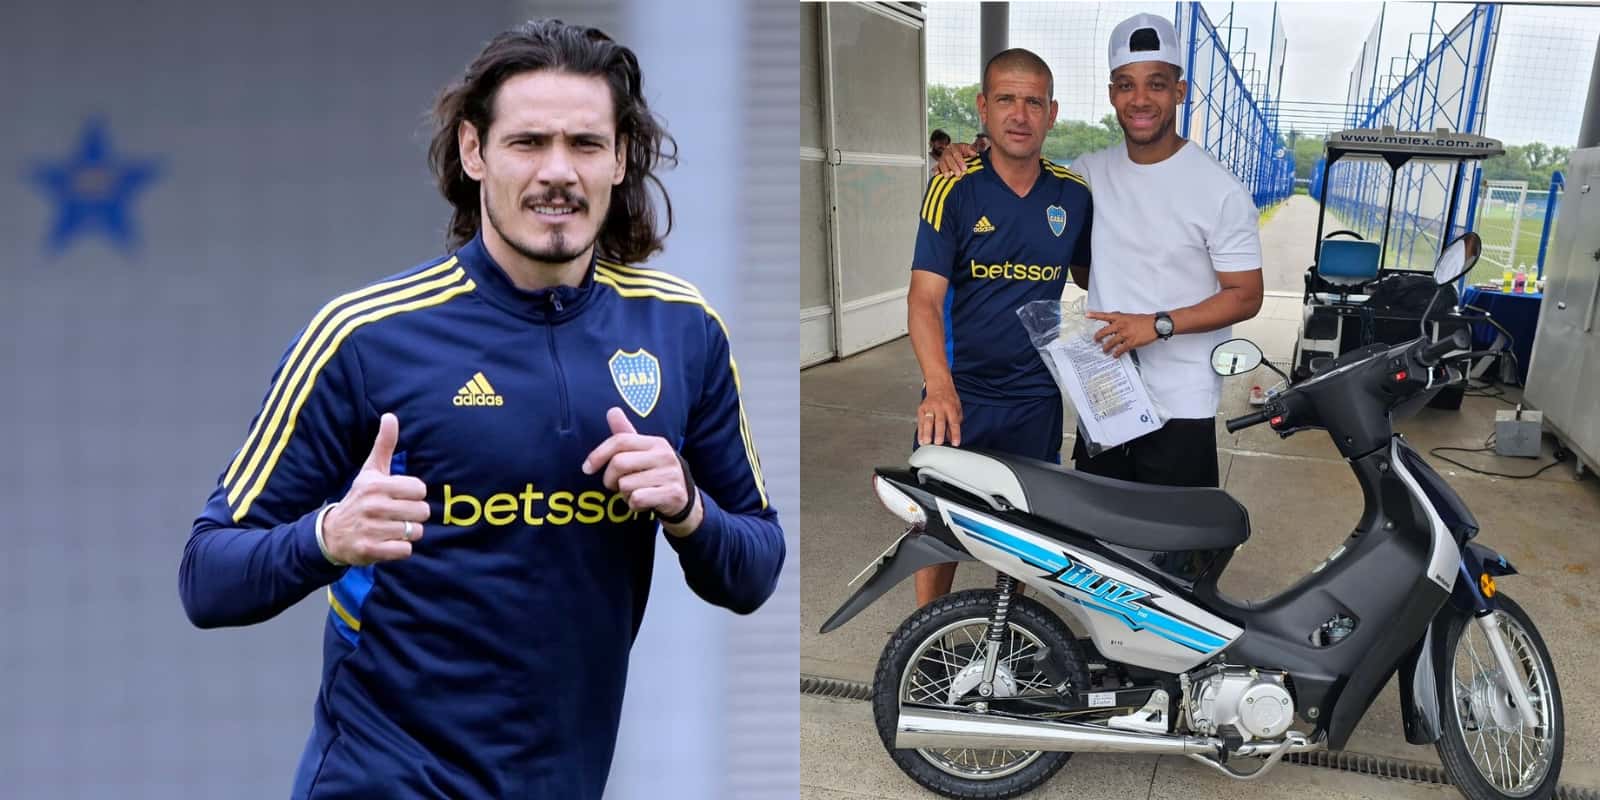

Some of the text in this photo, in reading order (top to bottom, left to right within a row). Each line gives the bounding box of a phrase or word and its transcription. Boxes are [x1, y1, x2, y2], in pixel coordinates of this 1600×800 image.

[1340, 133, 1494, 149] www.melex.com.ar
[970, 259, 1062, 281] betsson
[618, 372, 655, 386] CABJ
[452, 393, 504, 406] adidas
[443, 483, 655, 526] betsso
[1057, 559, 1151, 610] BLITZ
